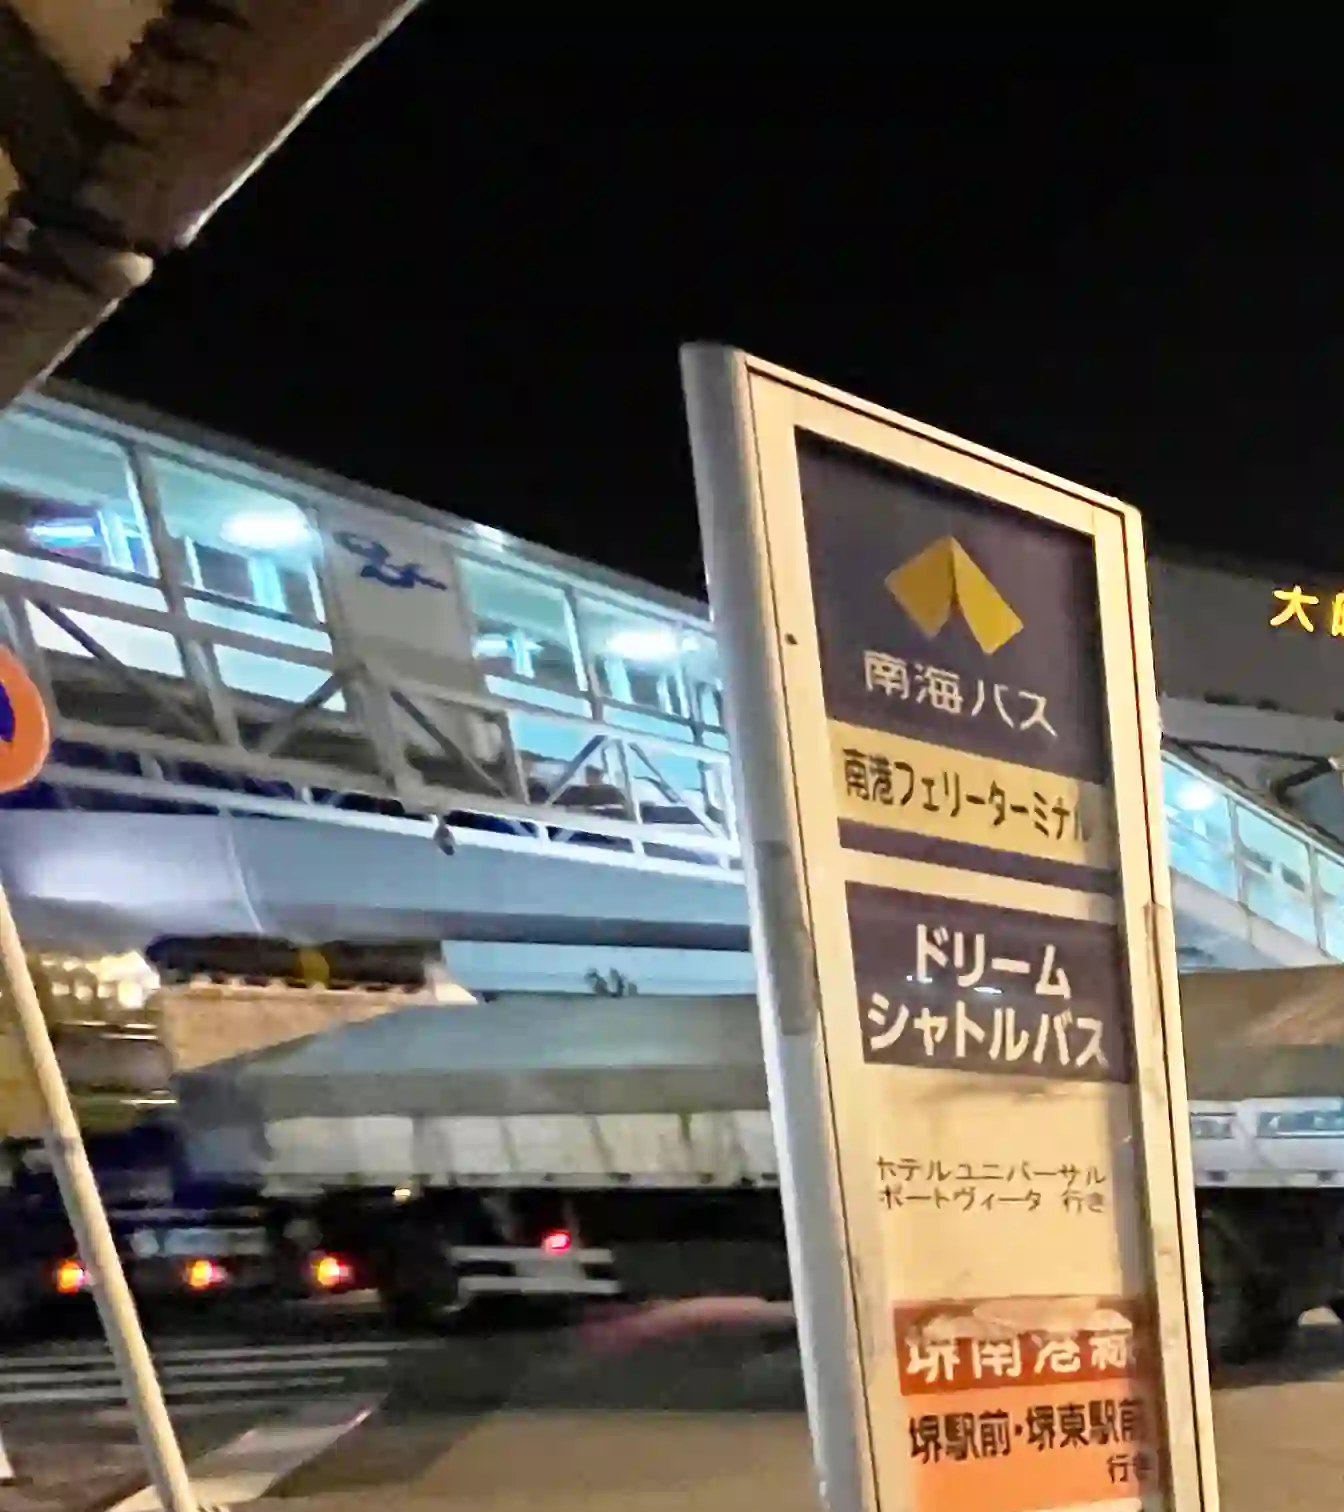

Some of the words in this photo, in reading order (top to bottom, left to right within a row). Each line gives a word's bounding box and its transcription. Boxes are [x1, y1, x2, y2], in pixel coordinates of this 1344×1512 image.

[863, 650, 1057, 738] 南海バス
[916, 923, 1071, 998] ドリーム
[867, 992, 1109, 1068] シャトルバス
[877, 1156, 1106, 1185] ホテルユニバーサル
